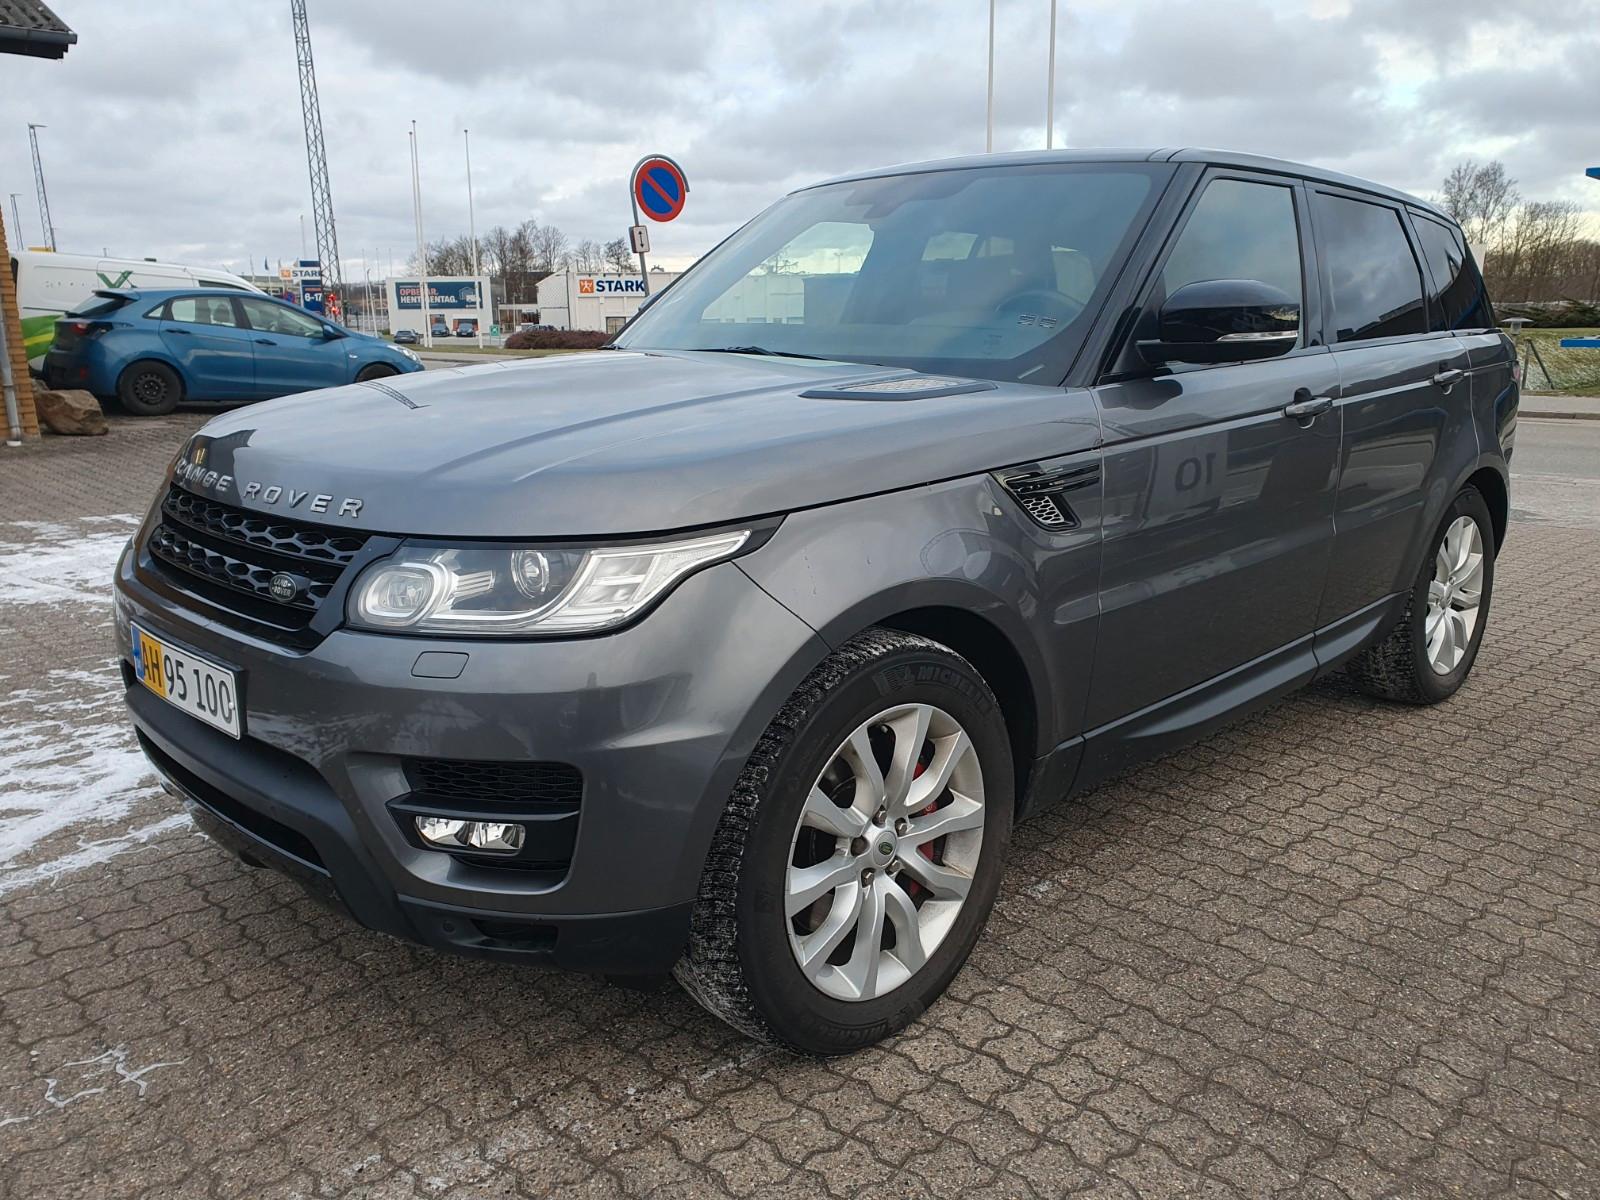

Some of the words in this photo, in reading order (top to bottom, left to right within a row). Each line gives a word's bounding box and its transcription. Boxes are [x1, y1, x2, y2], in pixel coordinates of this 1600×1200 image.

[596, 280, 646, 292] STARK
[175, 458, 233, 492] RANGE
[243, 481, 364, 518] ROVER
[141, 640, 163, 689] AH
[164, 654, 188, 702] 95
[193, 668, 234, 724] 100
